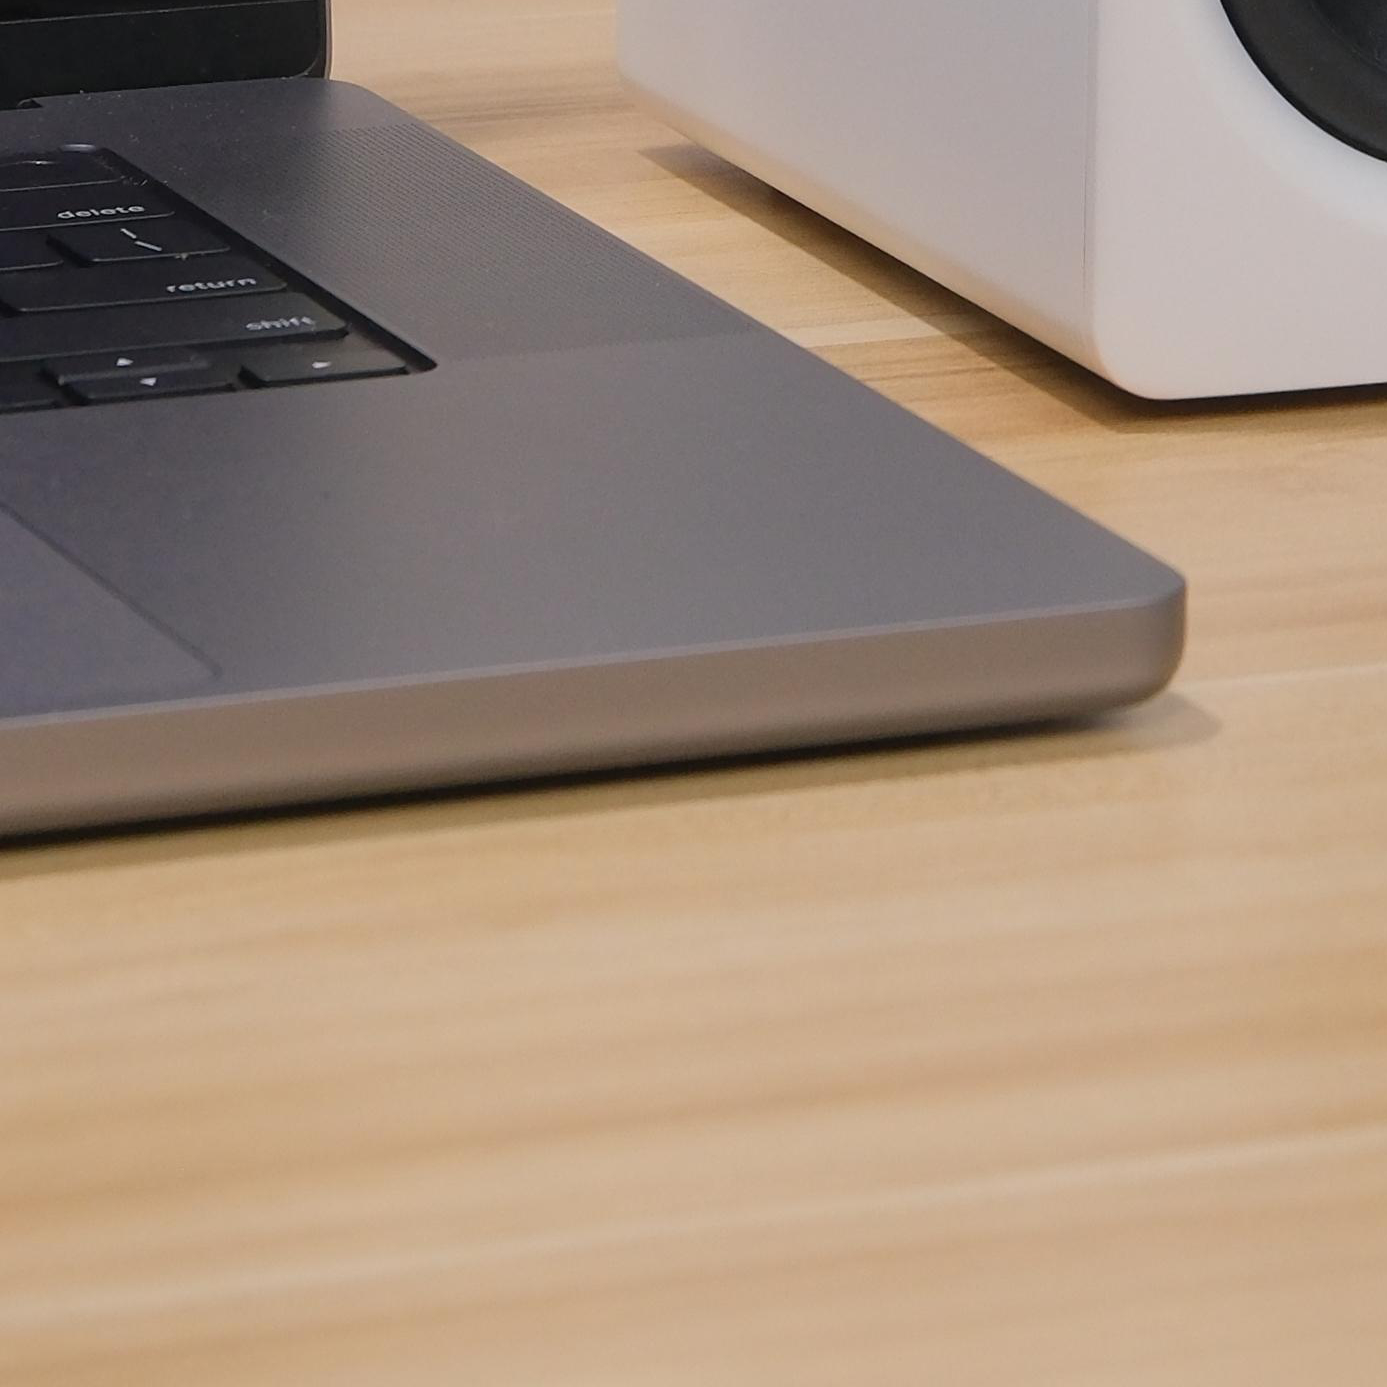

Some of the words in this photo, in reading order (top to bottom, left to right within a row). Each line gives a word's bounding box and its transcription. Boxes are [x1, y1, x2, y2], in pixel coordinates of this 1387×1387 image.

[57, 204, 146, 220] delete
[166, 277, 257, 293] return
[246, 315, 316, 331] shift
